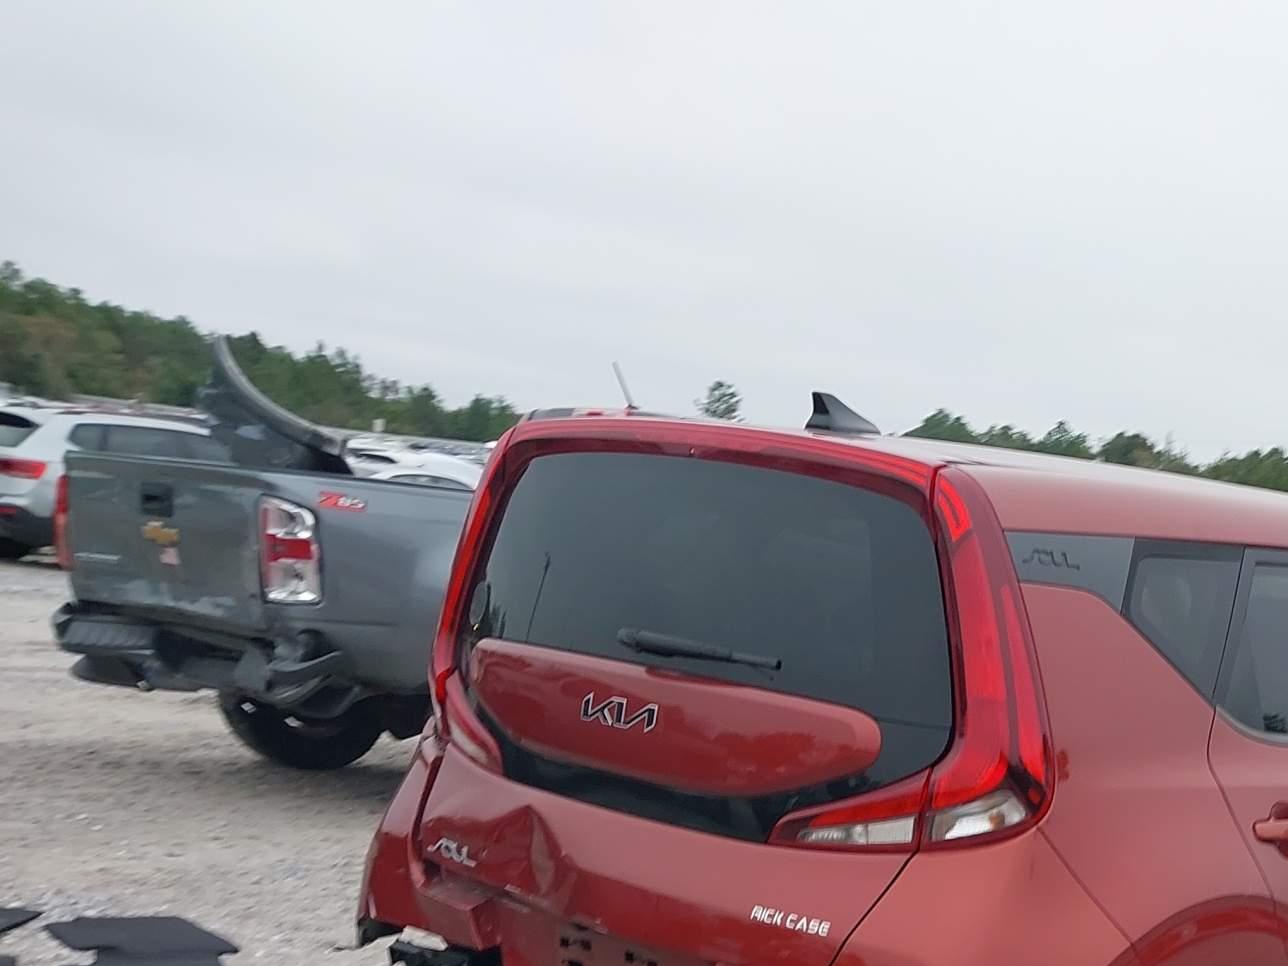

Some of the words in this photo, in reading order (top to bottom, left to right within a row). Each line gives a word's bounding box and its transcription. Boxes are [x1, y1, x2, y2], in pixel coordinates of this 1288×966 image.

[581, 691, 659, 733] KIA
[750, 904, 784, 926] RICK
[785, 912, 831, 937] CASE
